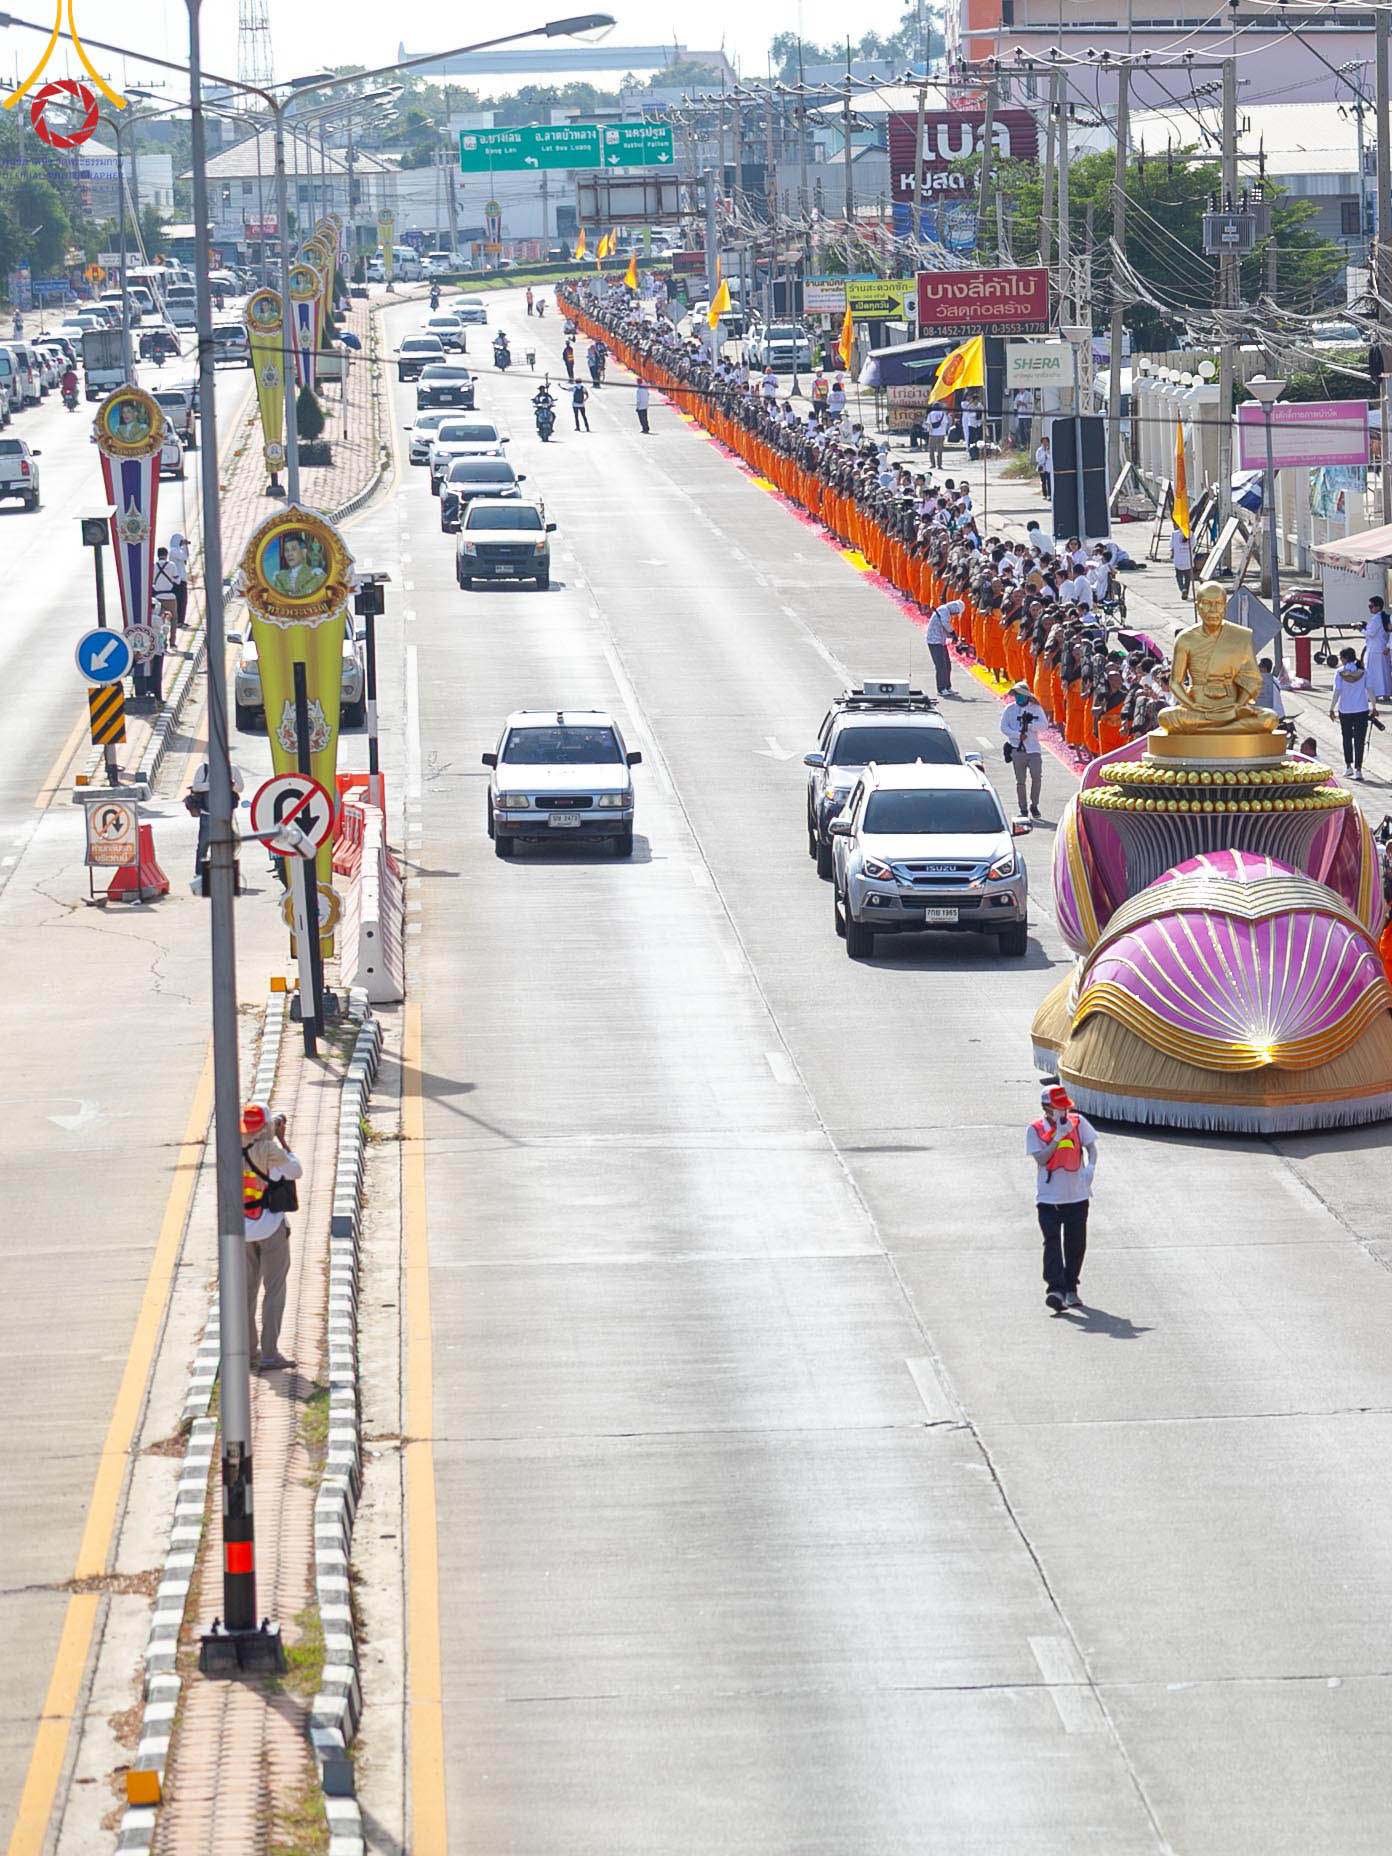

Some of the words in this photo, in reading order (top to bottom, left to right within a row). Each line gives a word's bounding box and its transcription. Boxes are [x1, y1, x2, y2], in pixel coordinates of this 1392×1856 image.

[624, 125, 666, 141] นครปฐม
[926, 274, 1038, 299] บางลี่ค้าไม้
[935, 303, 1031, 321] วัสดุก่อสร้าง
[922, 326, 982, 337] 08-1452-7122
[991, 322, 1046, 334] 0-3553-1778
[1013, 356, 1061, 370] SHERA
